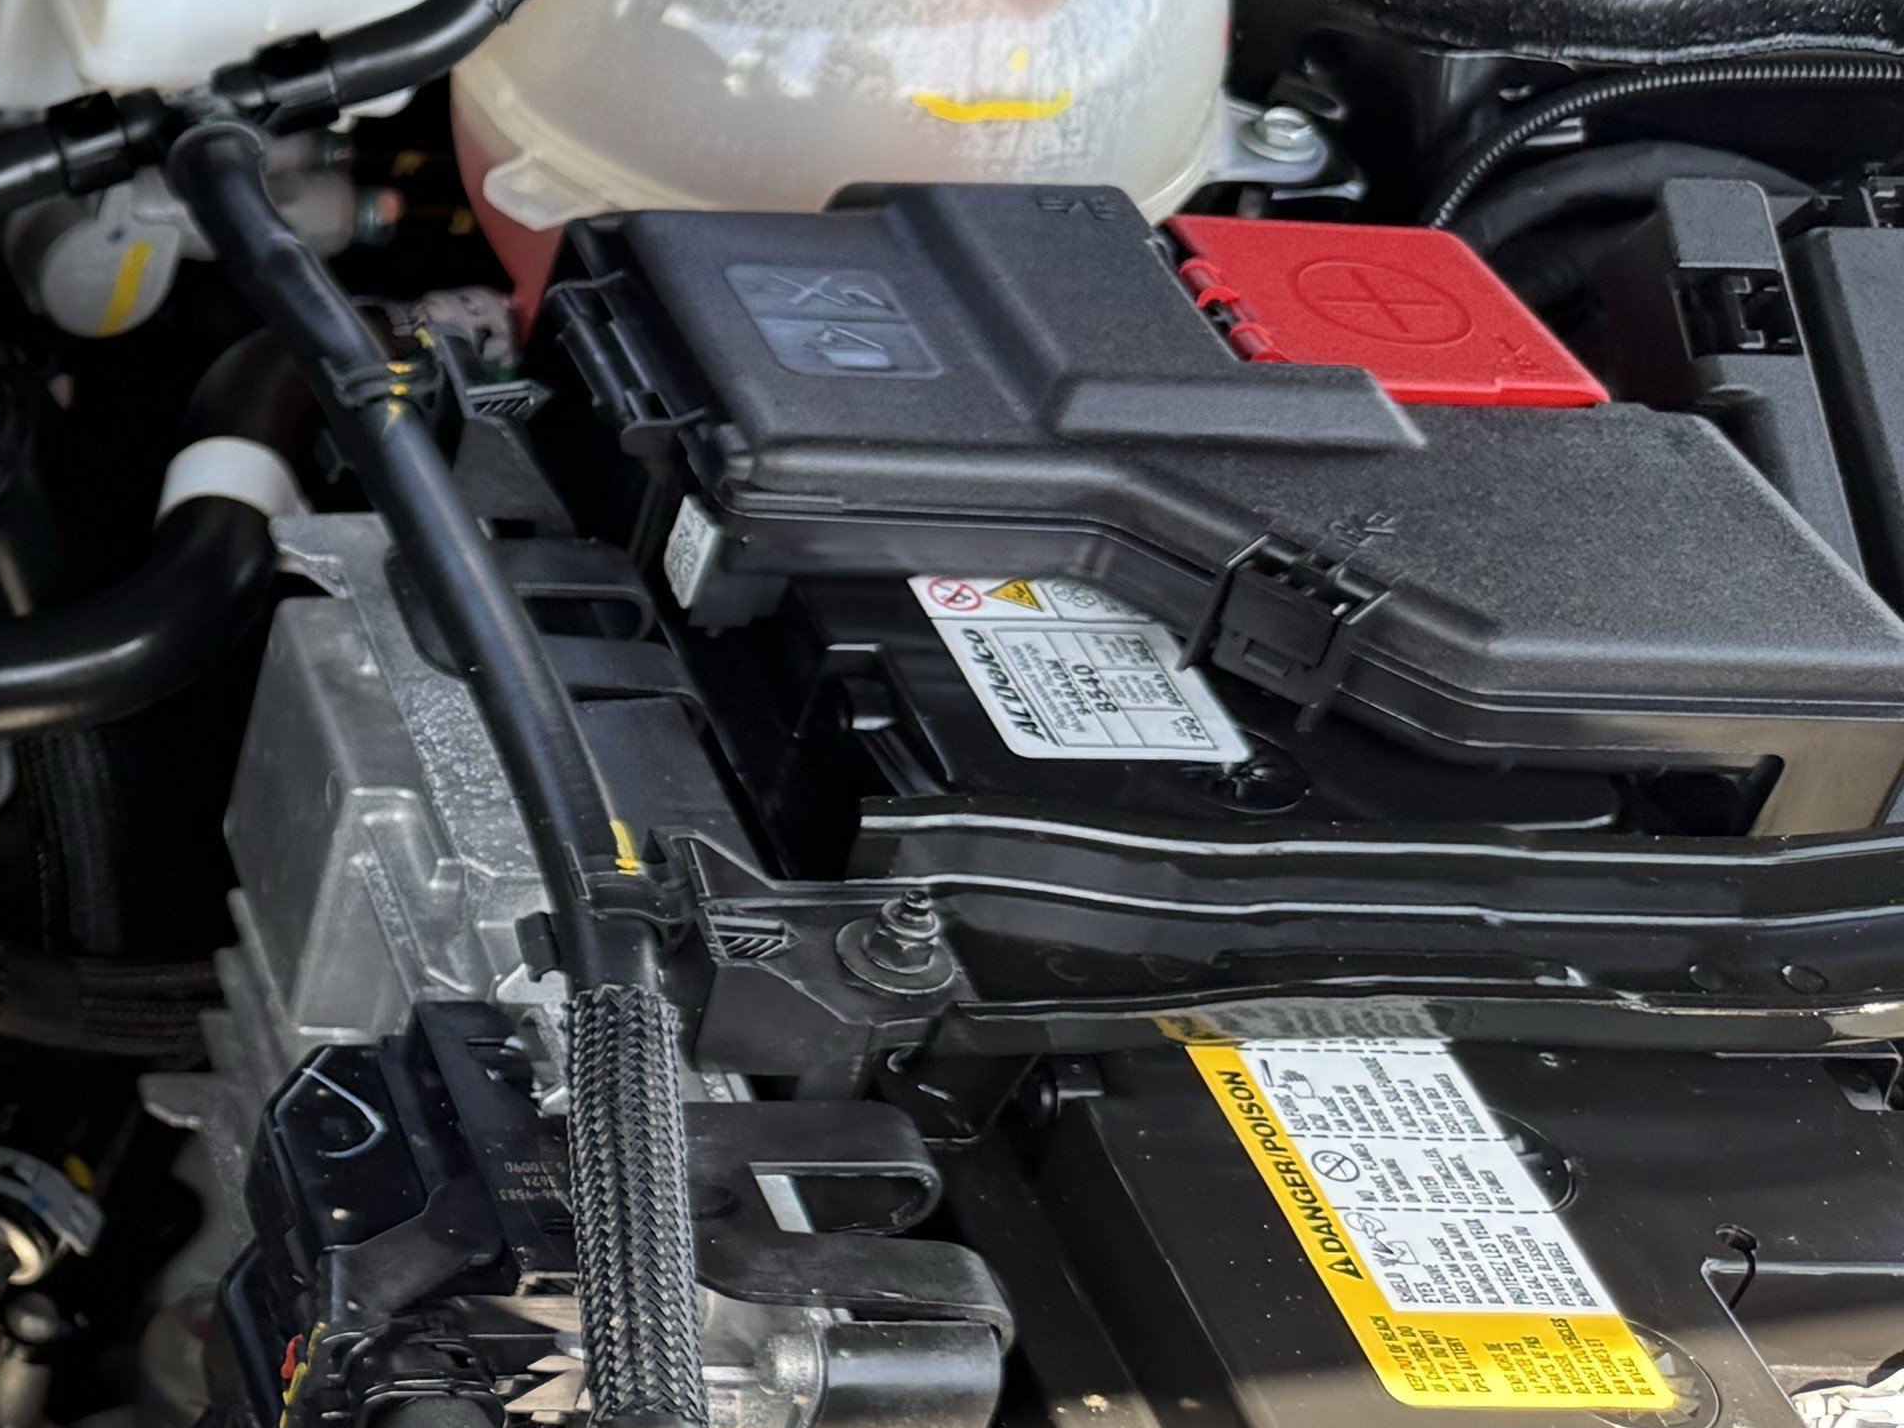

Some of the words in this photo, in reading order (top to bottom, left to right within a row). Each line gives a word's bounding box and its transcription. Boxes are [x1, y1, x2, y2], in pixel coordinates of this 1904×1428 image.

[960, 626, 1049, 743] ACDelco
[1070, 662, 1122, 716] 8540
[1181, 715, 1207, 742] 730
[1358, 1056, 1405, 1103] SULFURIQUE
[1316, 1095, 1345, 1117] CAUSE
[1304, 1112, 1333, 1131] ACID
[1331, 1118, 1354, 1132] CAN
[1214, 1069, 1348, 1253] DANGER/POISON
[1347, 1142, 1381, 1171] FLAMES
[1378, 1157, 1415, 1191] SMOKING
[1476, 1169, 1507, 1194] FUMER
[1354, 1189, 1379, 1202] NO
[1448, 1190, 1472, 1204] LES
[1470, 1191, 1494, 1205] LES
[1493, 1196, 1515, 1205] DE
[1438, 1221, 1470, 1248] INJURY
[1461, 1218, 1491, 1240] YEUX
[1510, 1225, 1532, 1236] OU
[1426, 1236, 1456, 1261] CAUSE
[1455, 1250, 1478, 1260] OR
[1475, 1242, 1503, 1258] LES
[1493, 1233, 1534, 1273] EXPLOSIFS
[1518, 1237, 1554, 1271] BLESSER
[1540, 1241, 1577, 1275] AVEUGLE
[1443, 1262, 1467, 1278] CAN
[1520, 1274, 1545, 1289] GAZ
[1382, 1271, 1419, 1303] SHIELD
[1411, 1281, 1441, 1303] EYES
[1421, 1263, 1461, 1303] EXPLOSIVE
[1453, 1279, 1483, 1303] GASES
[1463, 1262, 1505, 1304] BLINDNESS
[1540, 1272, 1576, 1306] PEUVENT
[1563, 1276, 1598, 1306] RENDRE
[1530, 1290, 1555, 1305] LES
